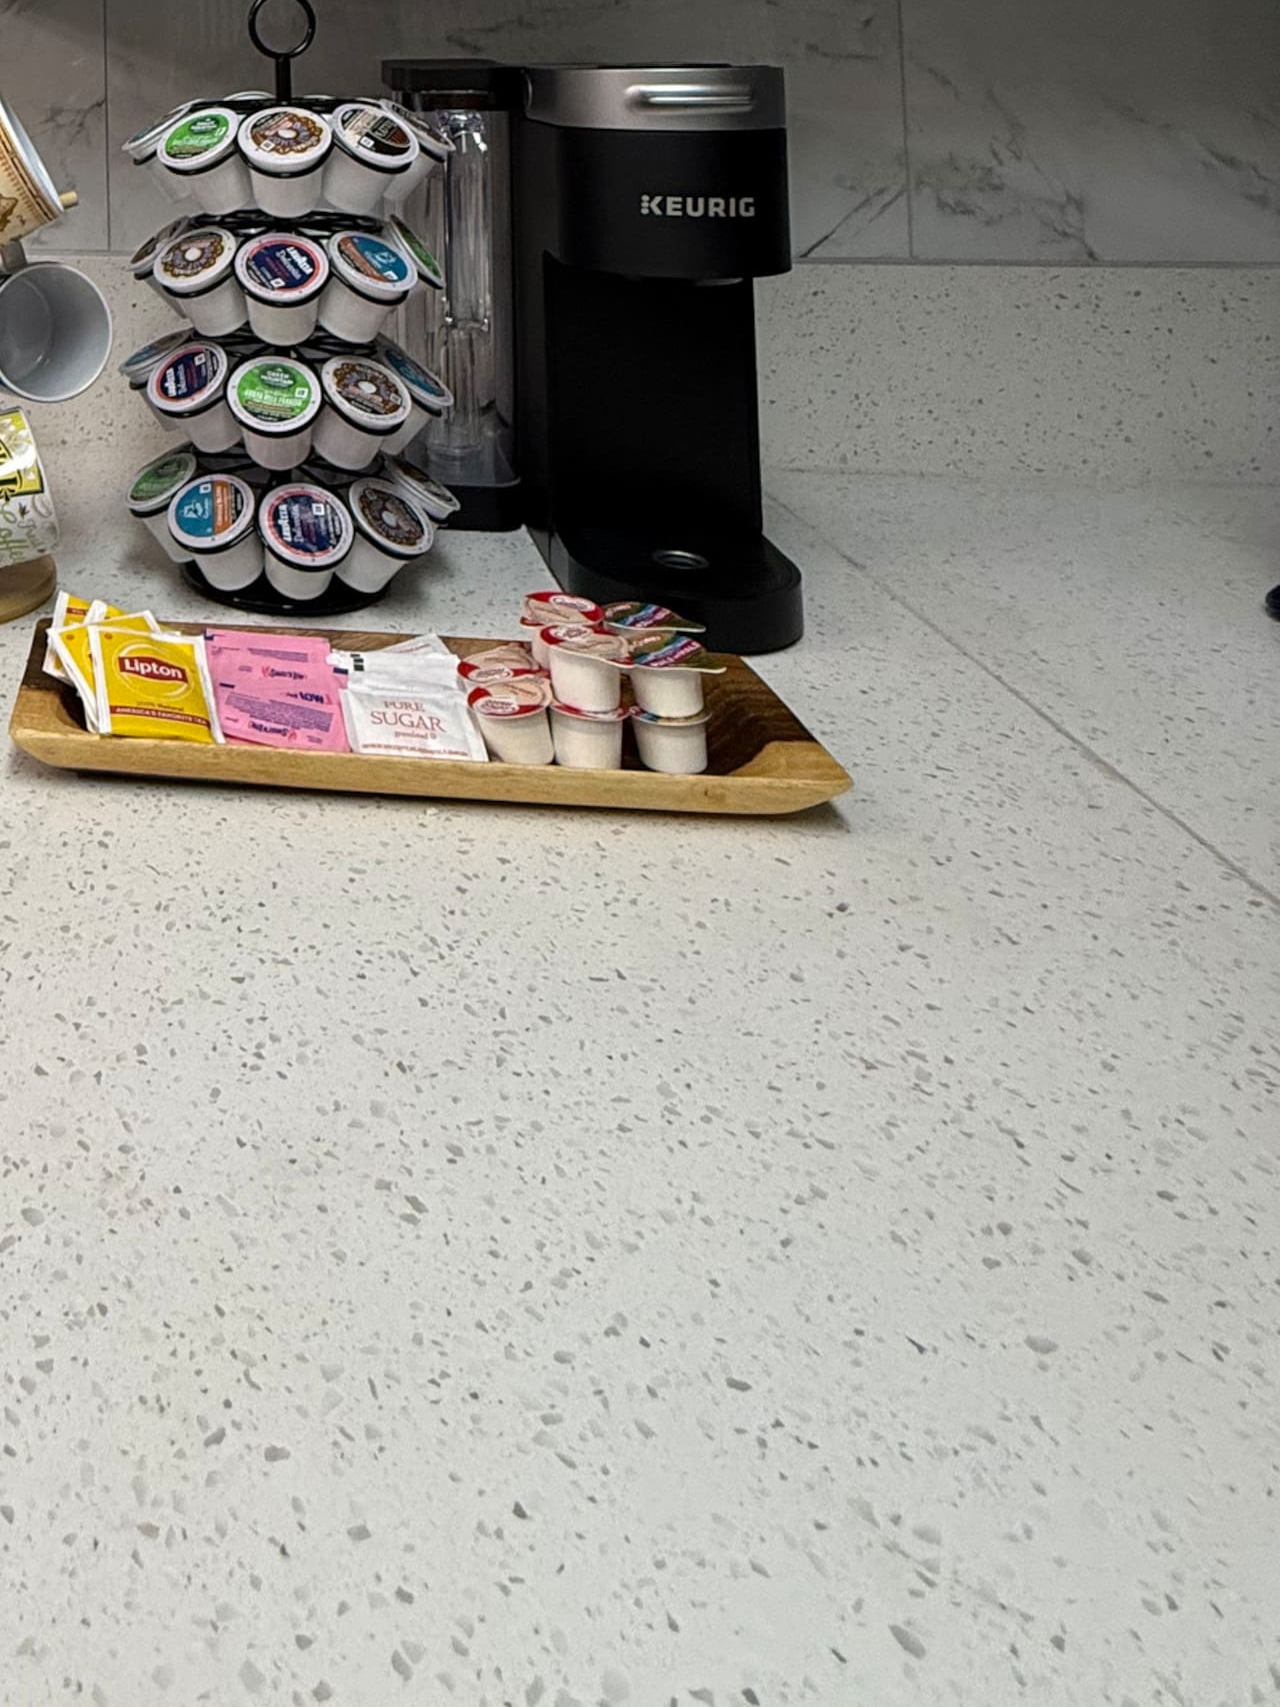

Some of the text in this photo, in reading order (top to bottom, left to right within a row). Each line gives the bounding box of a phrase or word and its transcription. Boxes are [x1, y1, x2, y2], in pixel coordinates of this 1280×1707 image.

[640, 194, 756, 218] KEURIG
[123, 658, 184, 679] Lipton
[115, 706, 208, 725] AMERICA'S FAVORITE TEA
[383, 700, 427, 713] PURE
[370, 710, 448, 733] SUGAR
